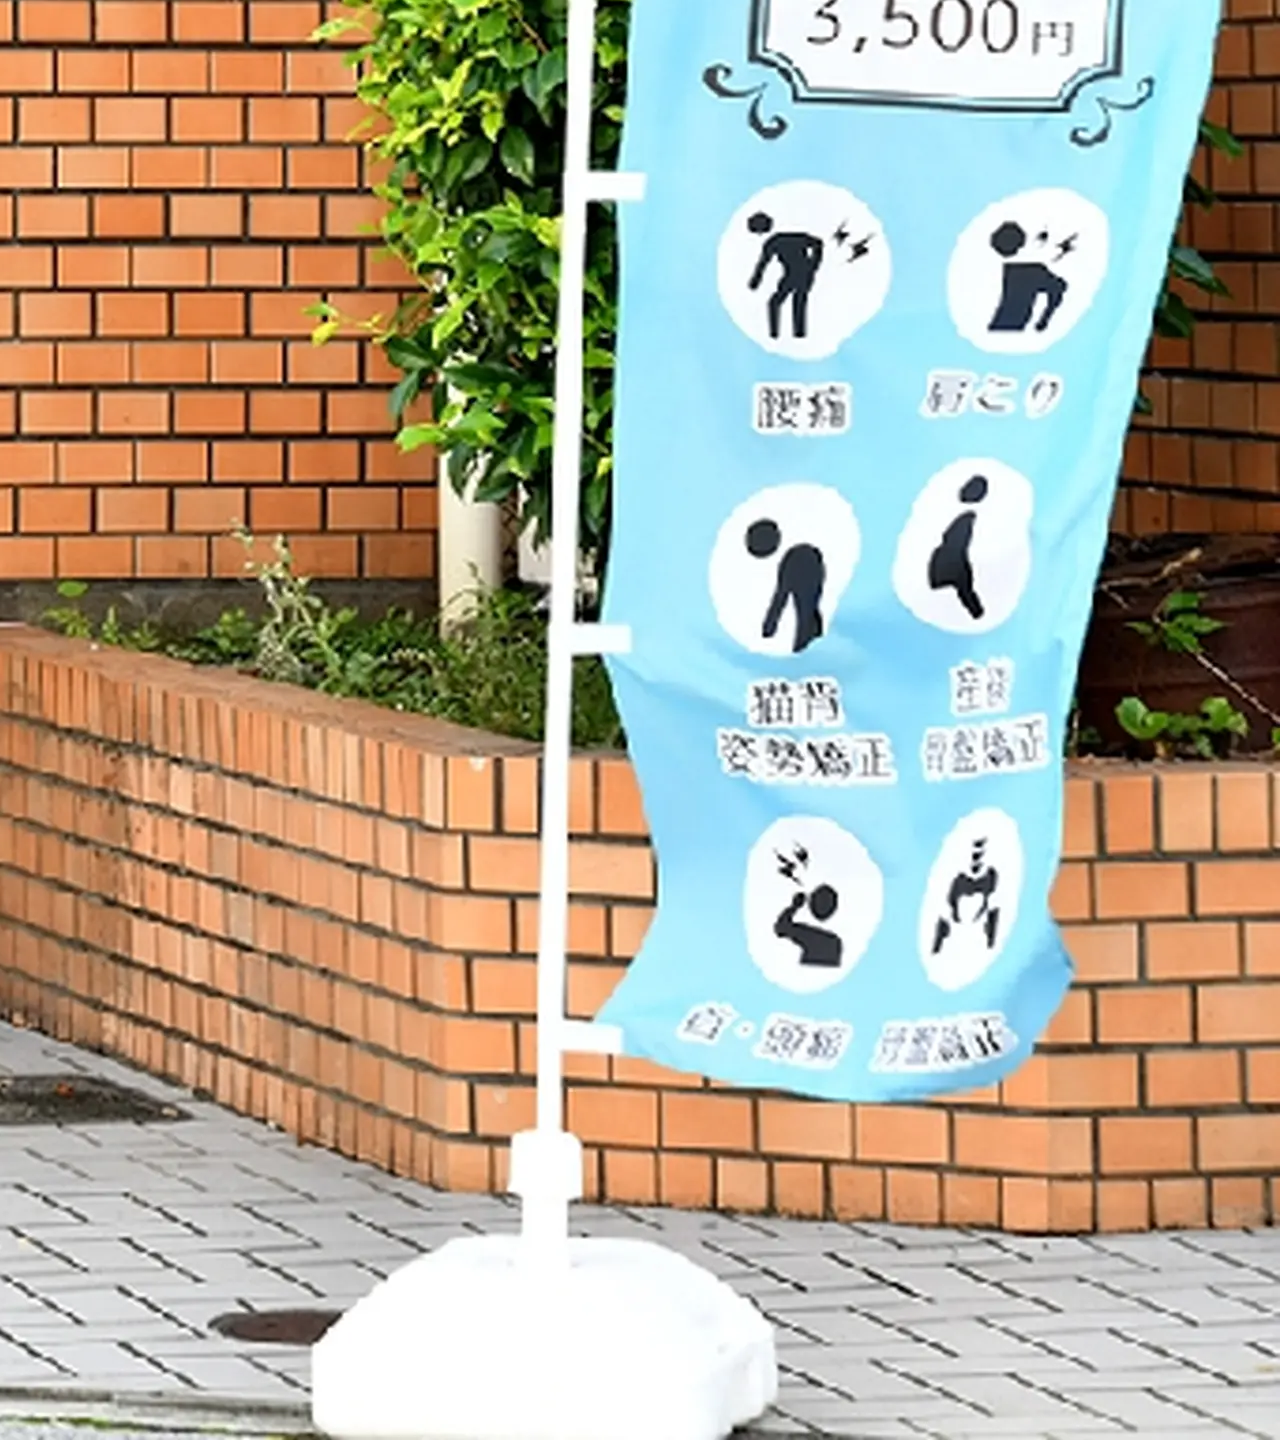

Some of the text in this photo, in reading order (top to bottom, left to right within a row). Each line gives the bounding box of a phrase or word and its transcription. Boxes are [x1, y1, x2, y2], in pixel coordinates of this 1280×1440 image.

[759, 376, 1060, 428] 腰痛 肩こり
[751, 683, 840, 724] 猫背
[722, 734, 892, 777] 姿勢矯正
